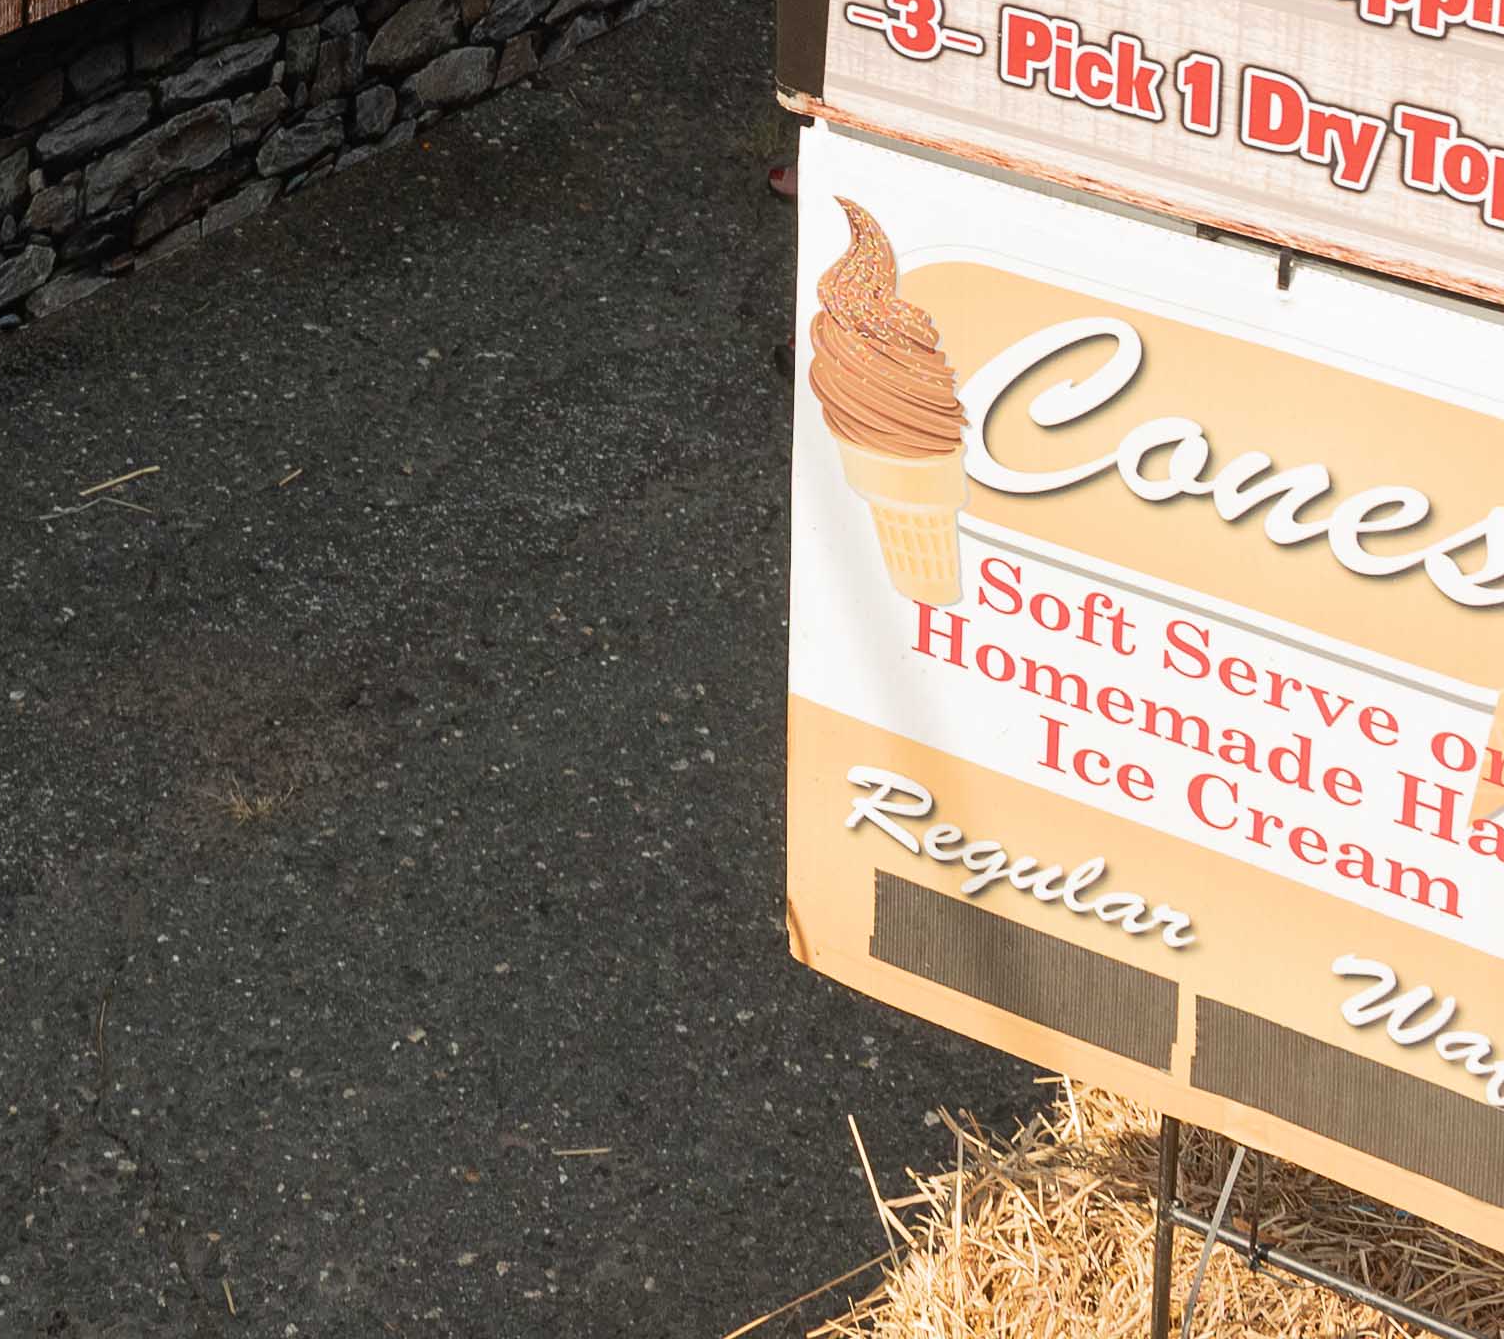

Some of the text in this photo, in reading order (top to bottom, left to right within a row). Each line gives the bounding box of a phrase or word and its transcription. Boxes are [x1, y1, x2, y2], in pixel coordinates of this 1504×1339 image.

[1000, 6, 1167, 121] Pick
[1175, 47, 1223, 136] 1
[1238, 71, 1392, 188] Dry
[912, 600, 1365, 807] Homemade
[976, 555, 1138, 657] Soft
[1161, 619, 1401, 748] Serve
[847, 763, 1197, 951] Regular
[1036, 714, 1464, 922] Ice Cream
